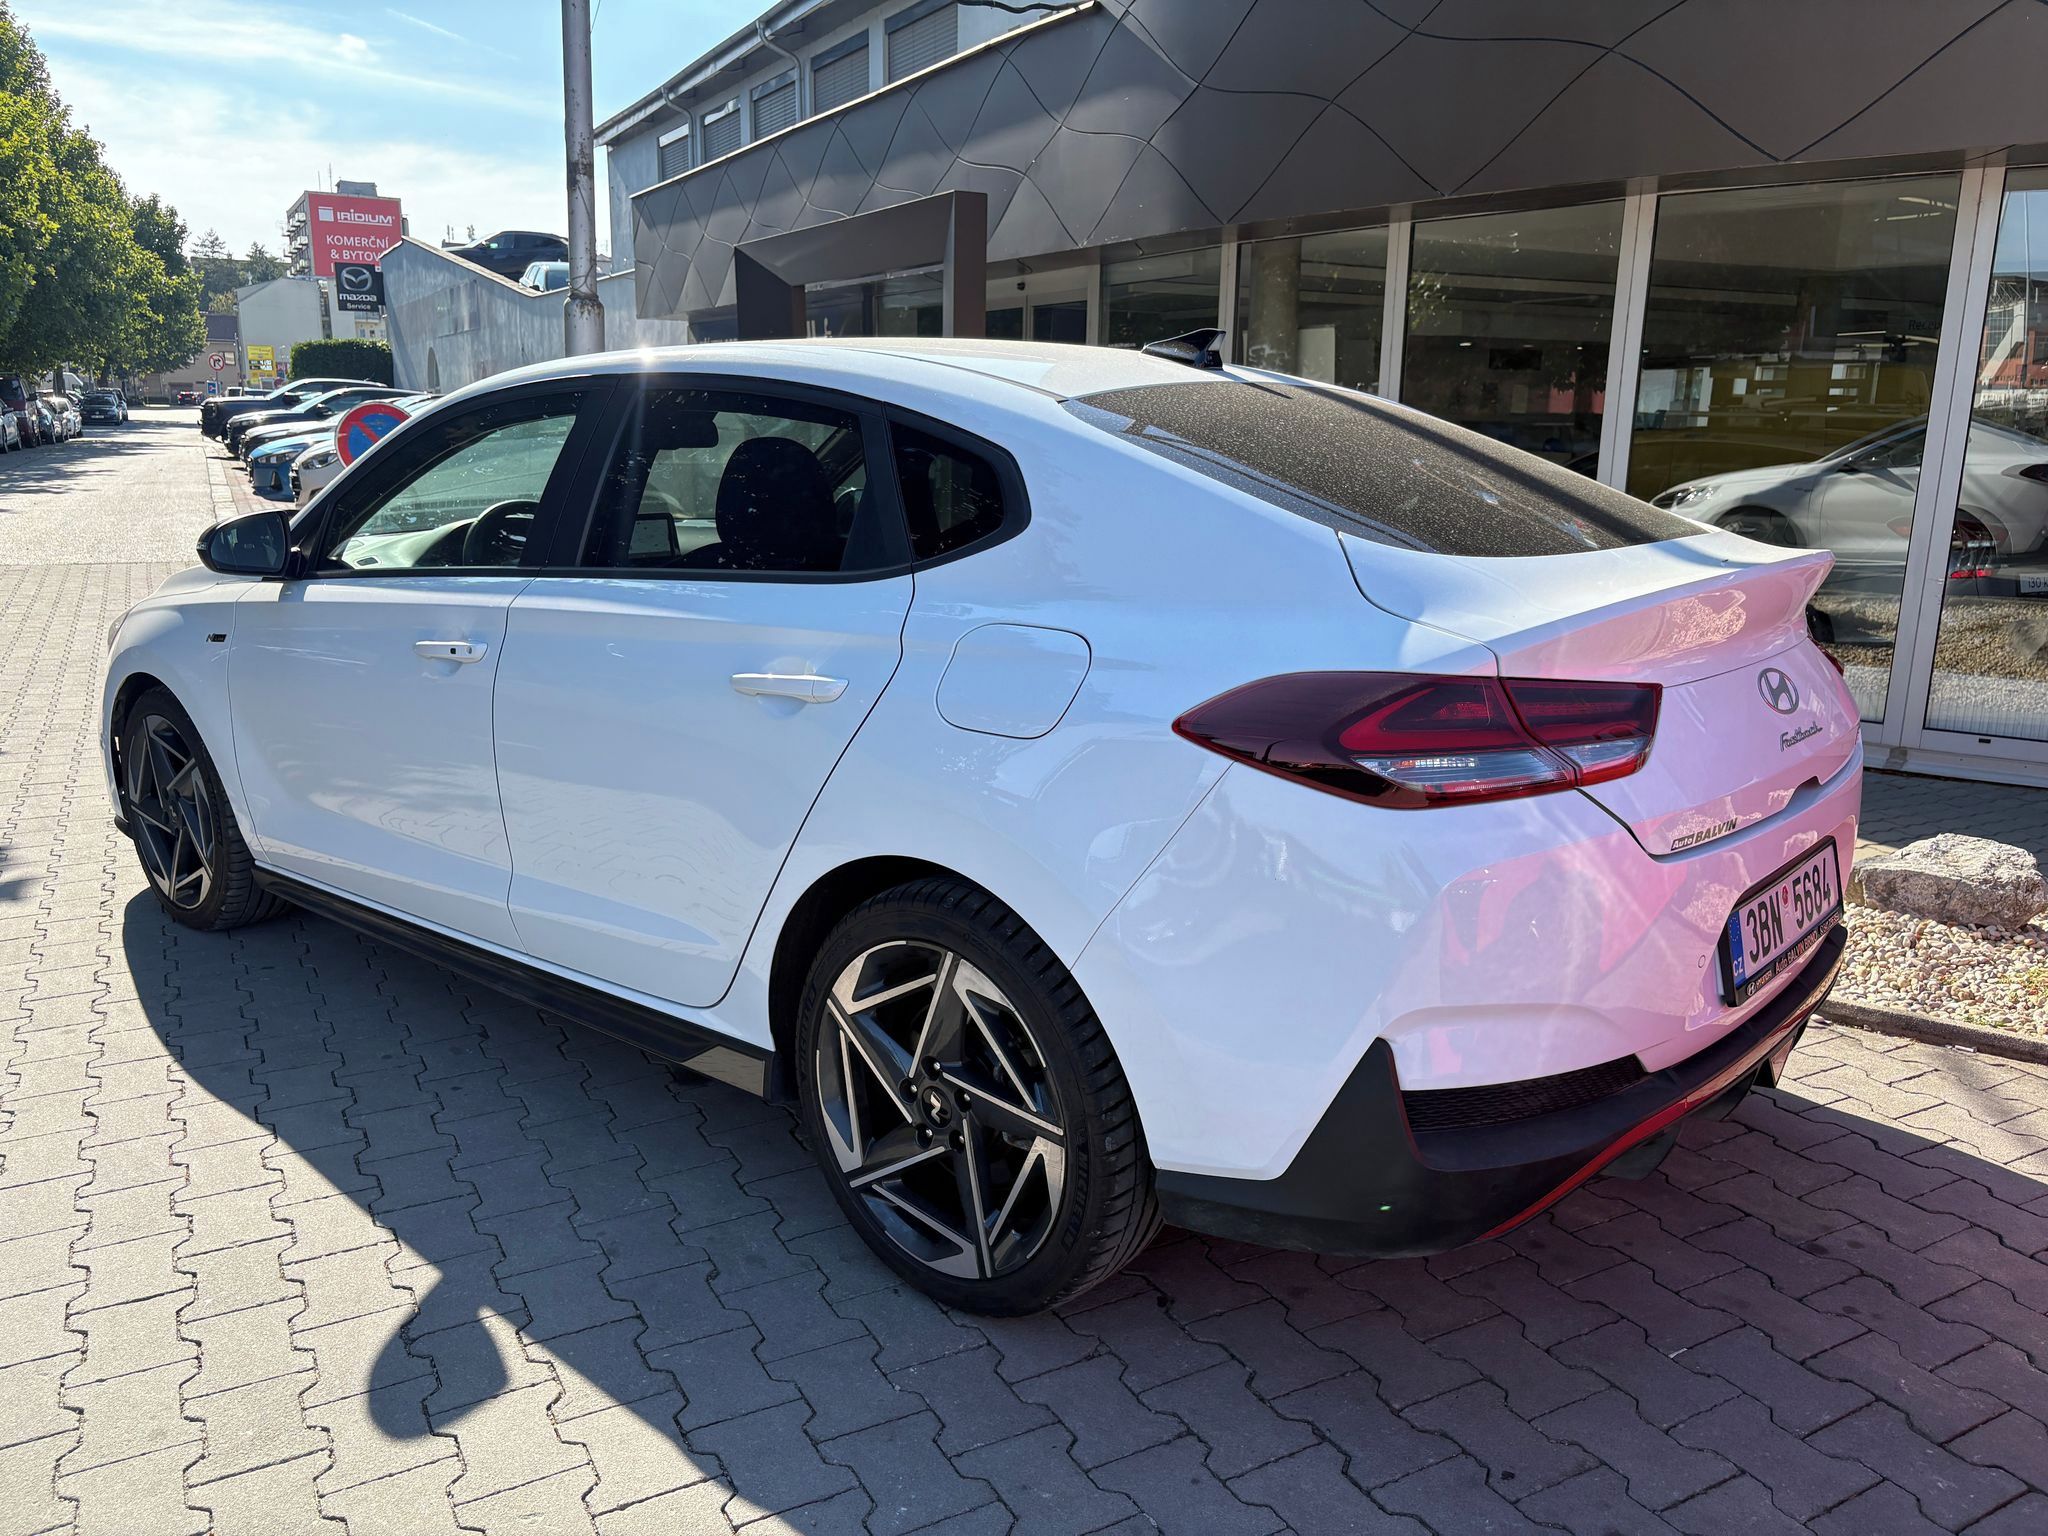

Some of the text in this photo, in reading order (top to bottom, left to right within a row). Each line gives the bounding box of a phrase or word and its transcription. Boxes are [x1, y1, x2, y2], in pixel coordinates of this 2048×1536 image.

[326, 234, 389, 249] KOMERČNÍ
[330, 249, 383, 262] & BYTOV
[346, 303, 371, 311] Service
[2028, 577, 2042, 588] i30
[1779, 720, 1823, 753] Fastback
[1673, 817, 1738, 849] Auto BALVIN
[1746, 857, 1832, 965] 3BN 5684
[1732, 956, 1744, 977] CZ
[1775, 957, 1788, 976] Auto
[1063, 1150, 1089, 1249] MICHELIN
